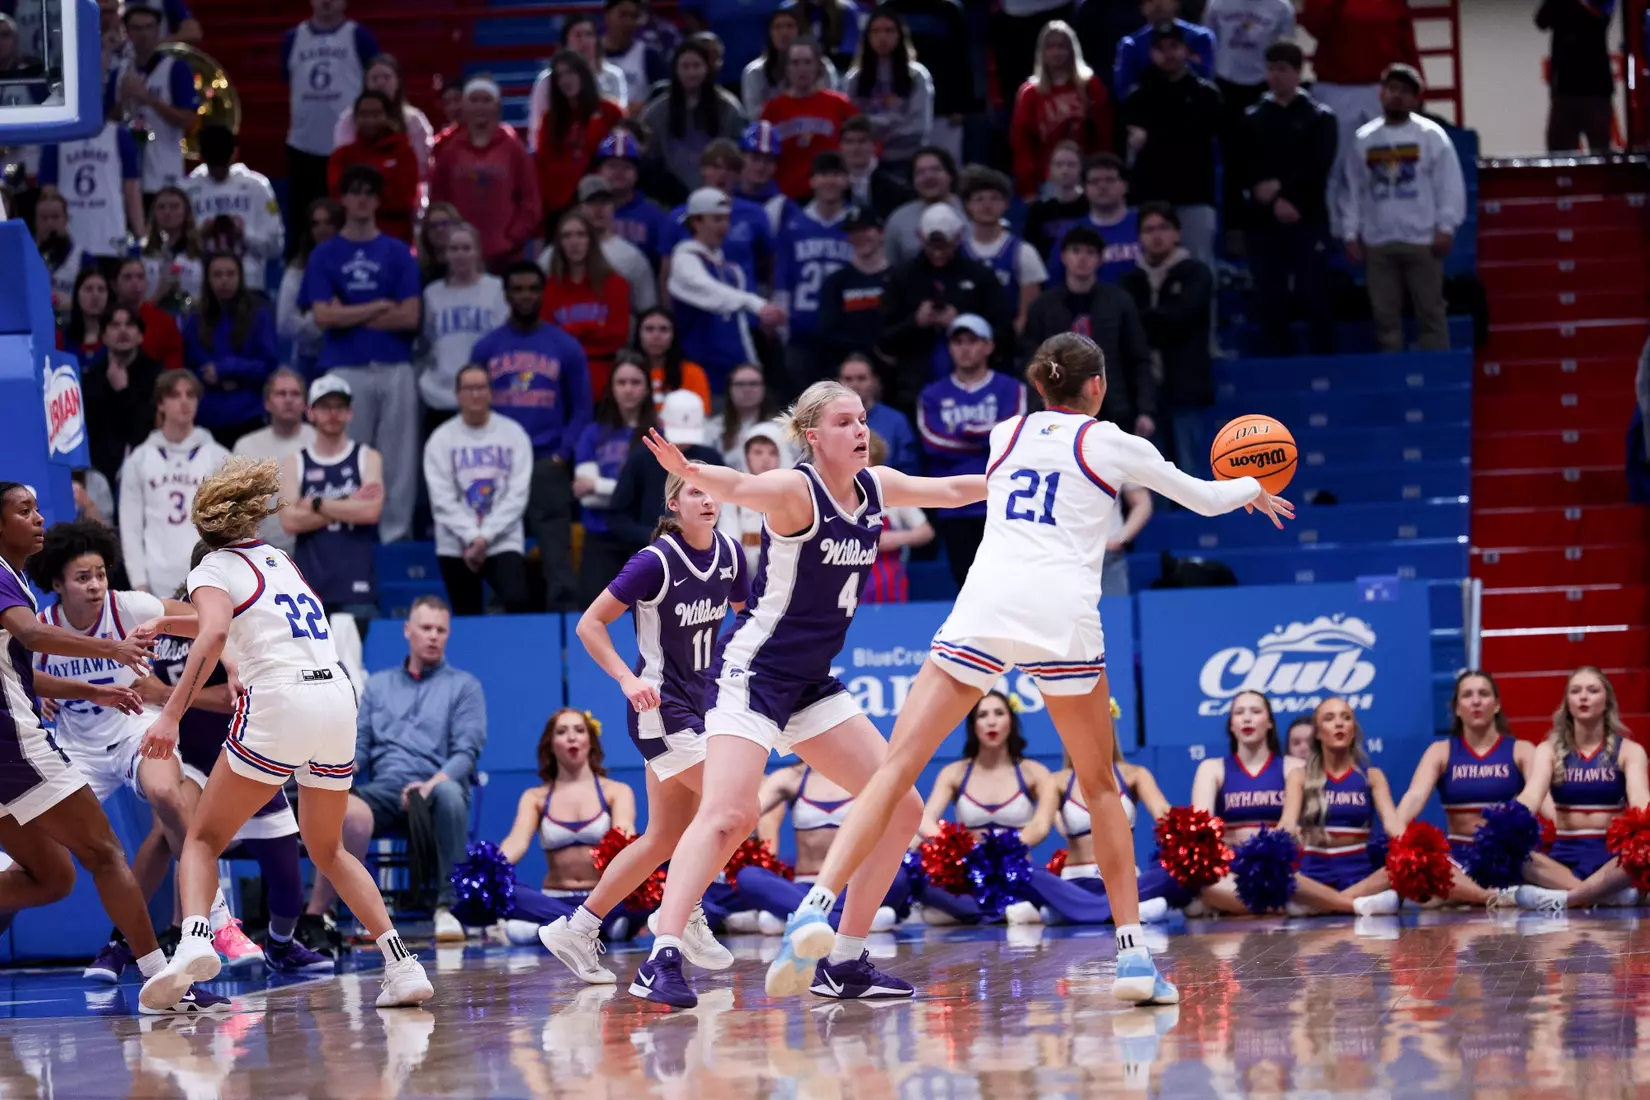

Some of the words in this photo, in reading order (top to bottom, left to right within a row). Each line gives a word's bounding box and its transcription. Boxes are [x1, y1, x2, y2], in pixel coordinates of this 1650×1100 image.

[309, 62, 331, 92] 6
[73, 164, 97, 198] 6
[1229, 448, 1287, 468] Wilson
[149, 474, 205, 491] KANSA
[1006, 469, 1060, 526] 21
[168, 490, 188, 526] 3
[820, 537, 878, 566] Wildcat
[837, 572, 860, 618] 4
[274, 592, 329, 641] 22
[674, 596, 729, 627] Wildcat
[692, 627, 713, 672] 11
[1199, 647, 1376, 699] Club
[1189, 744, 1206, 760] 13
[1452, 763, 1510, 782] JAYHAWKS
[1563, 767, 1616, 783] AYHAWKS
[1325, 790, 1366, 807] HAWKS
